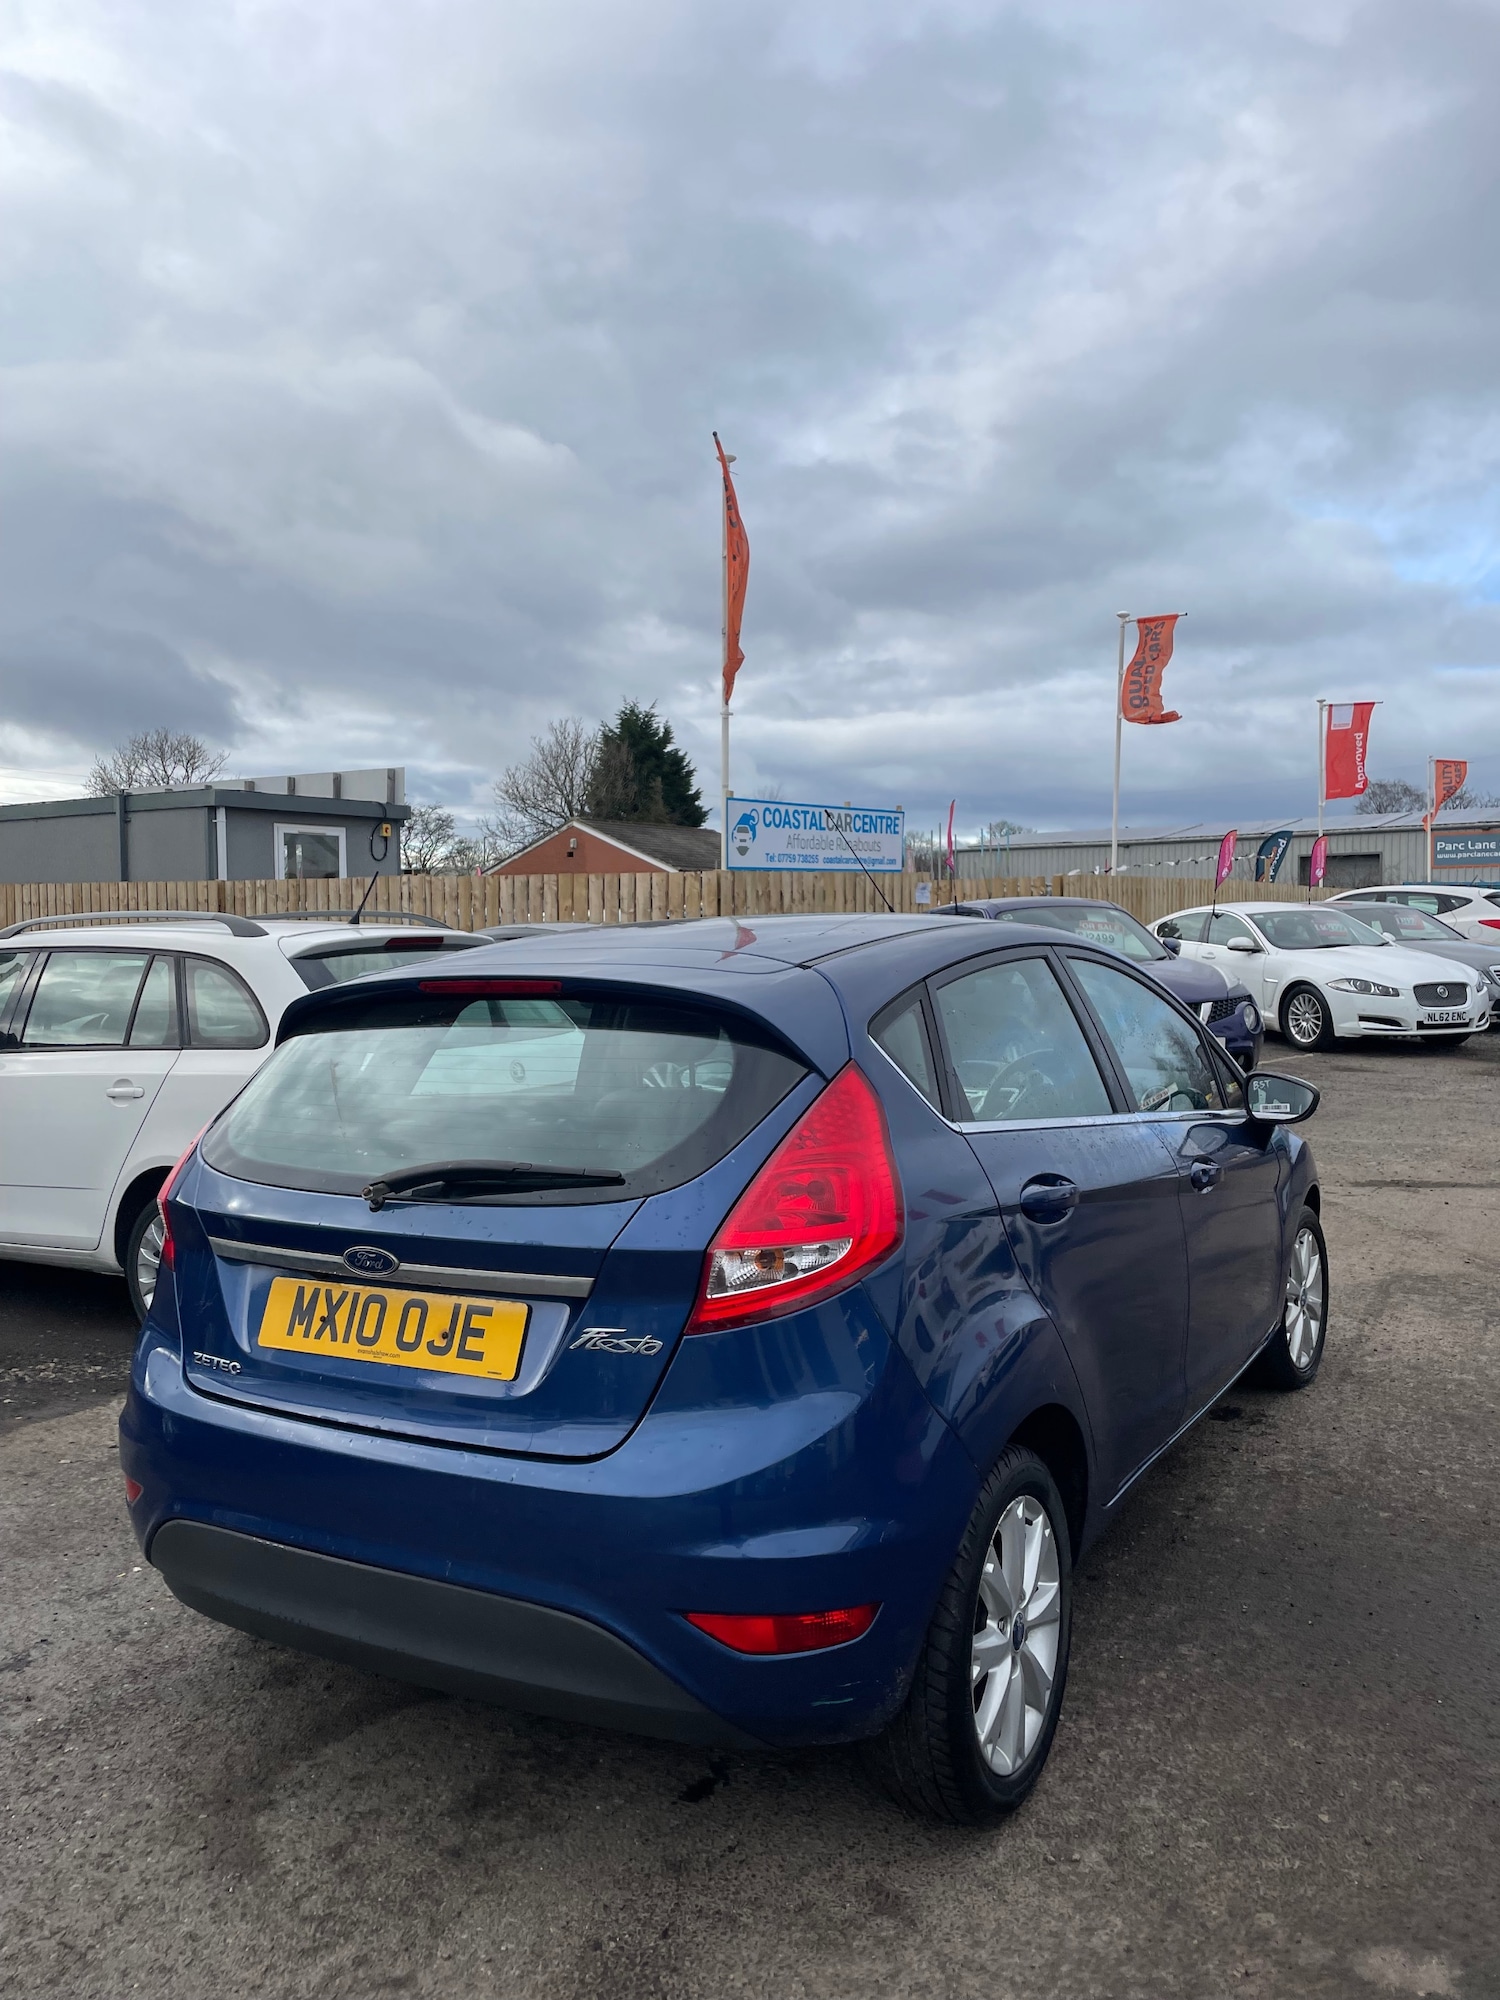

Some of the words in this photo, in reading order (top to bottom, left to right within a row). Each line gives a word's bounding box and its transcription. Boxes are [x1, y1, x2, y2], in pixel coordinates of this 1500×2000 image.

[1149, 621, 1166, 661] CARS
[1128, 624, 1153, 709] QUALY
[1354, 732, 1365, 789] Approved
[762, 807, 900, 834] COASTALCARCENTRE
[786, 834, 834, 850] Affordable
[1436, 841, 1465, 851] Parc
[1467, 840, 1497, 850] Lane
[765, 852, 777, 863] Tel:
[1427, 1012, 1450, 1022] NL62
[1451, 1011, 1467, 1021] ENC
[355, 1252, 384, 1269] Ford
[286, 1286, 388, 1347] MX10
[396, 1298, 493, 1361] OJE
[569, 1326, 663, 1355] Fiesta
[193, 1351, 241, 1375] ZETEC
